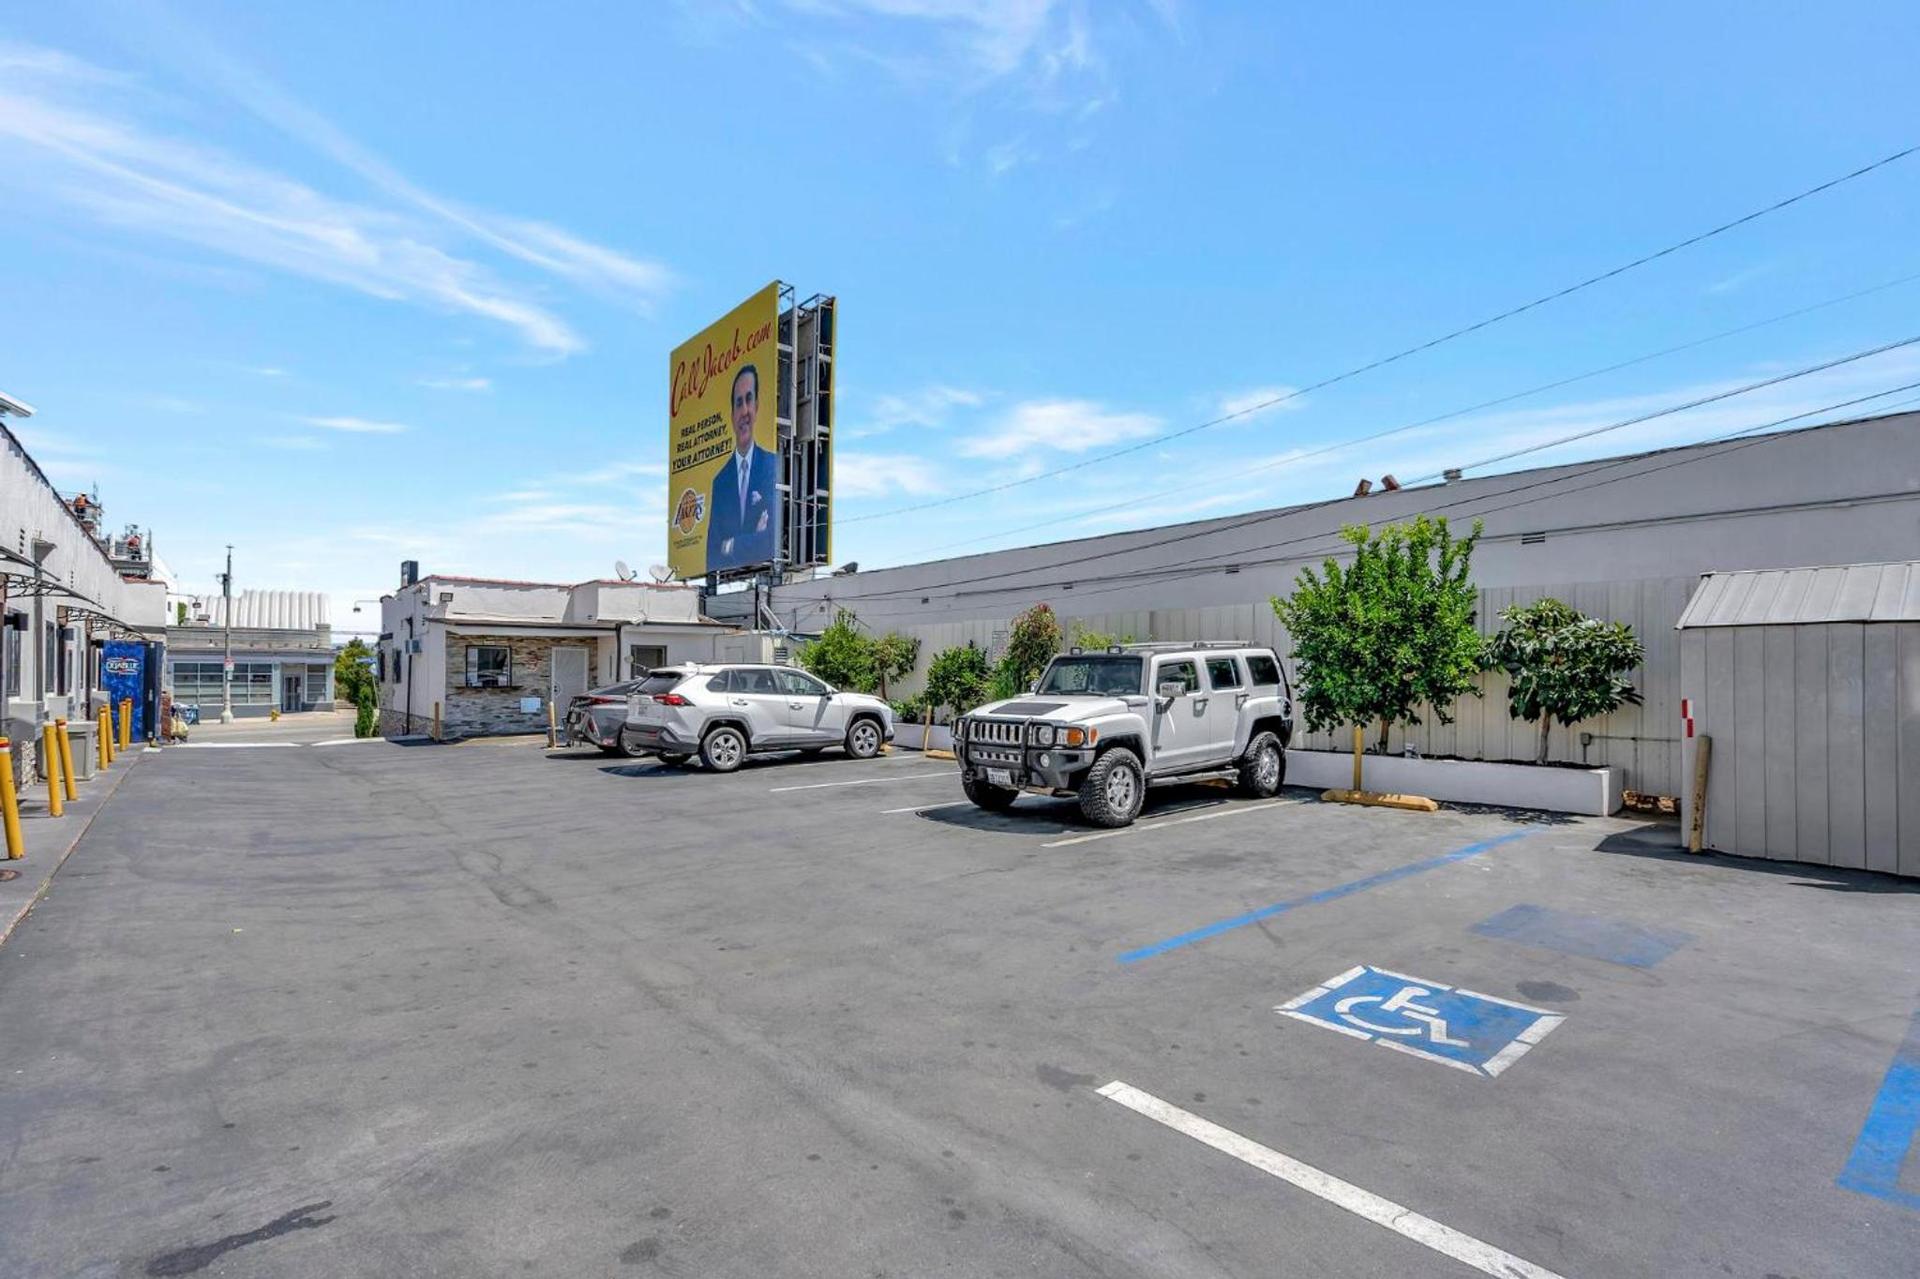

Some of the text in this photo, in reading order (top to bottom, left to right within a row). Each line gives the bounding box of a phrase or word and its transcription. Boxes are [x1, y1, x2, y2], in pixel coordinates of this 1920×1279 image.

[681, 425, 696, 437] REAL
[677, 440, 692, 453] REAL
[672, 455, 691, 470] YOUR
